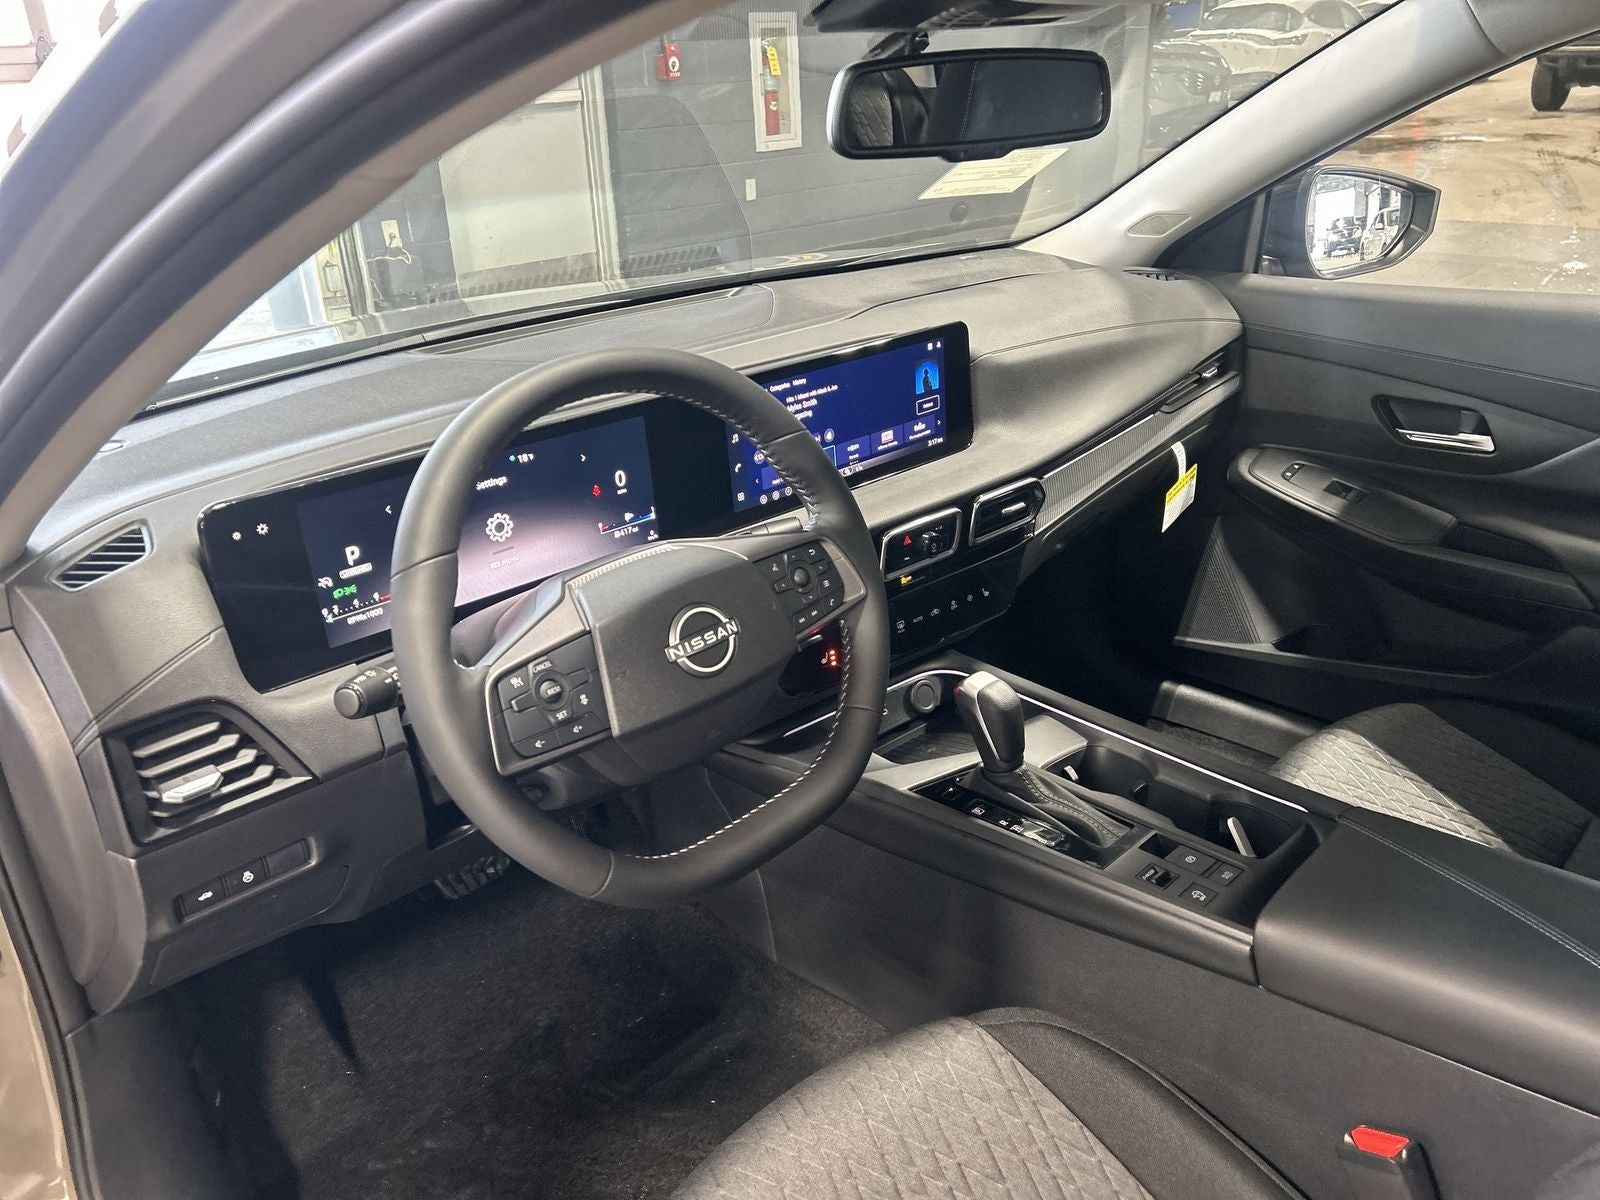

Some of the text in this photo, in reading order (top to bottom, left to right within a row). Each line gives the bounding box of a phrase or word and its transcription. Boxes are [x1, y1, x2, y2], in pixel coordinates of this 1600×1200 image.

[614, 469, 626, 487] 0
[345, 545, 360, 566] P
[668, 620, 738, 660] NISSAN
[533, 661, 553, 673] CANCEL
[555, 710, 568, 721] SET
